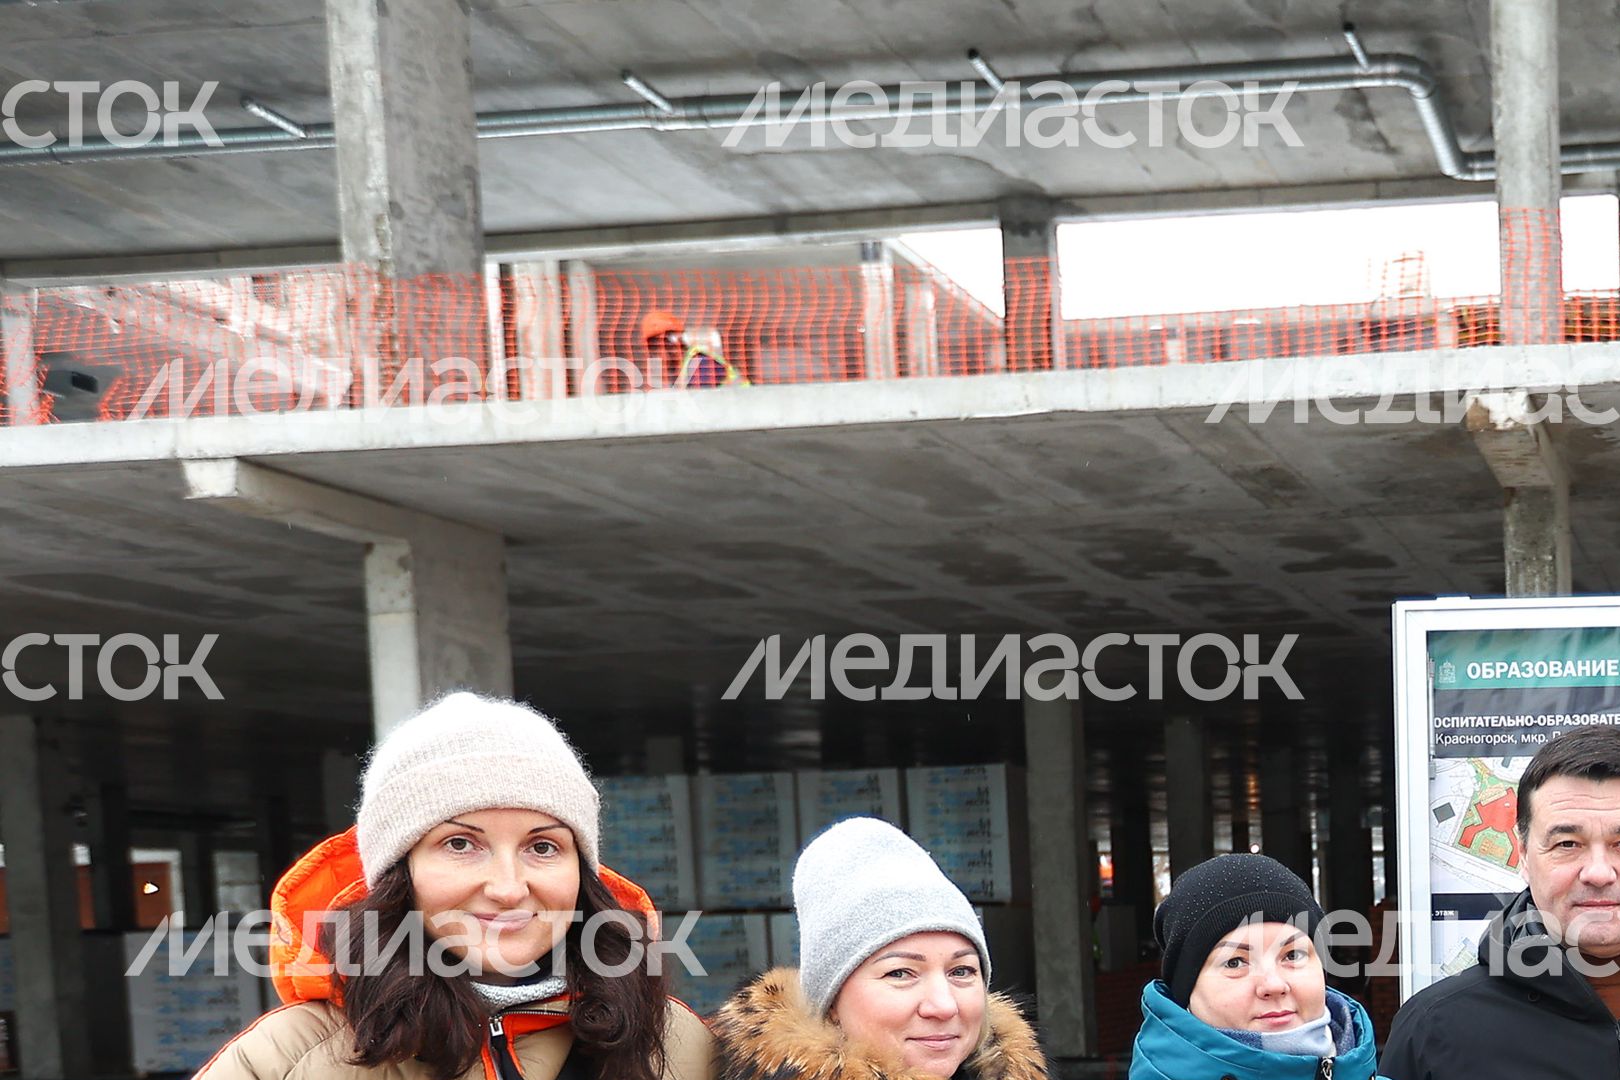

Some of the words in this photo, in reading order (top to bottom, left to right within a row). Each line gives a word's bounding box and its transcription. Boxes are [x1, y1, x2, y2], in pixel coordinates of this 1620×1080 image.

[1466, 659, 1619, 680] ОБРАЗОВАНИЕ
[1436, 733, 1518, 745] Красногорск,
[1521, 733, 1549, 744] мкр.
